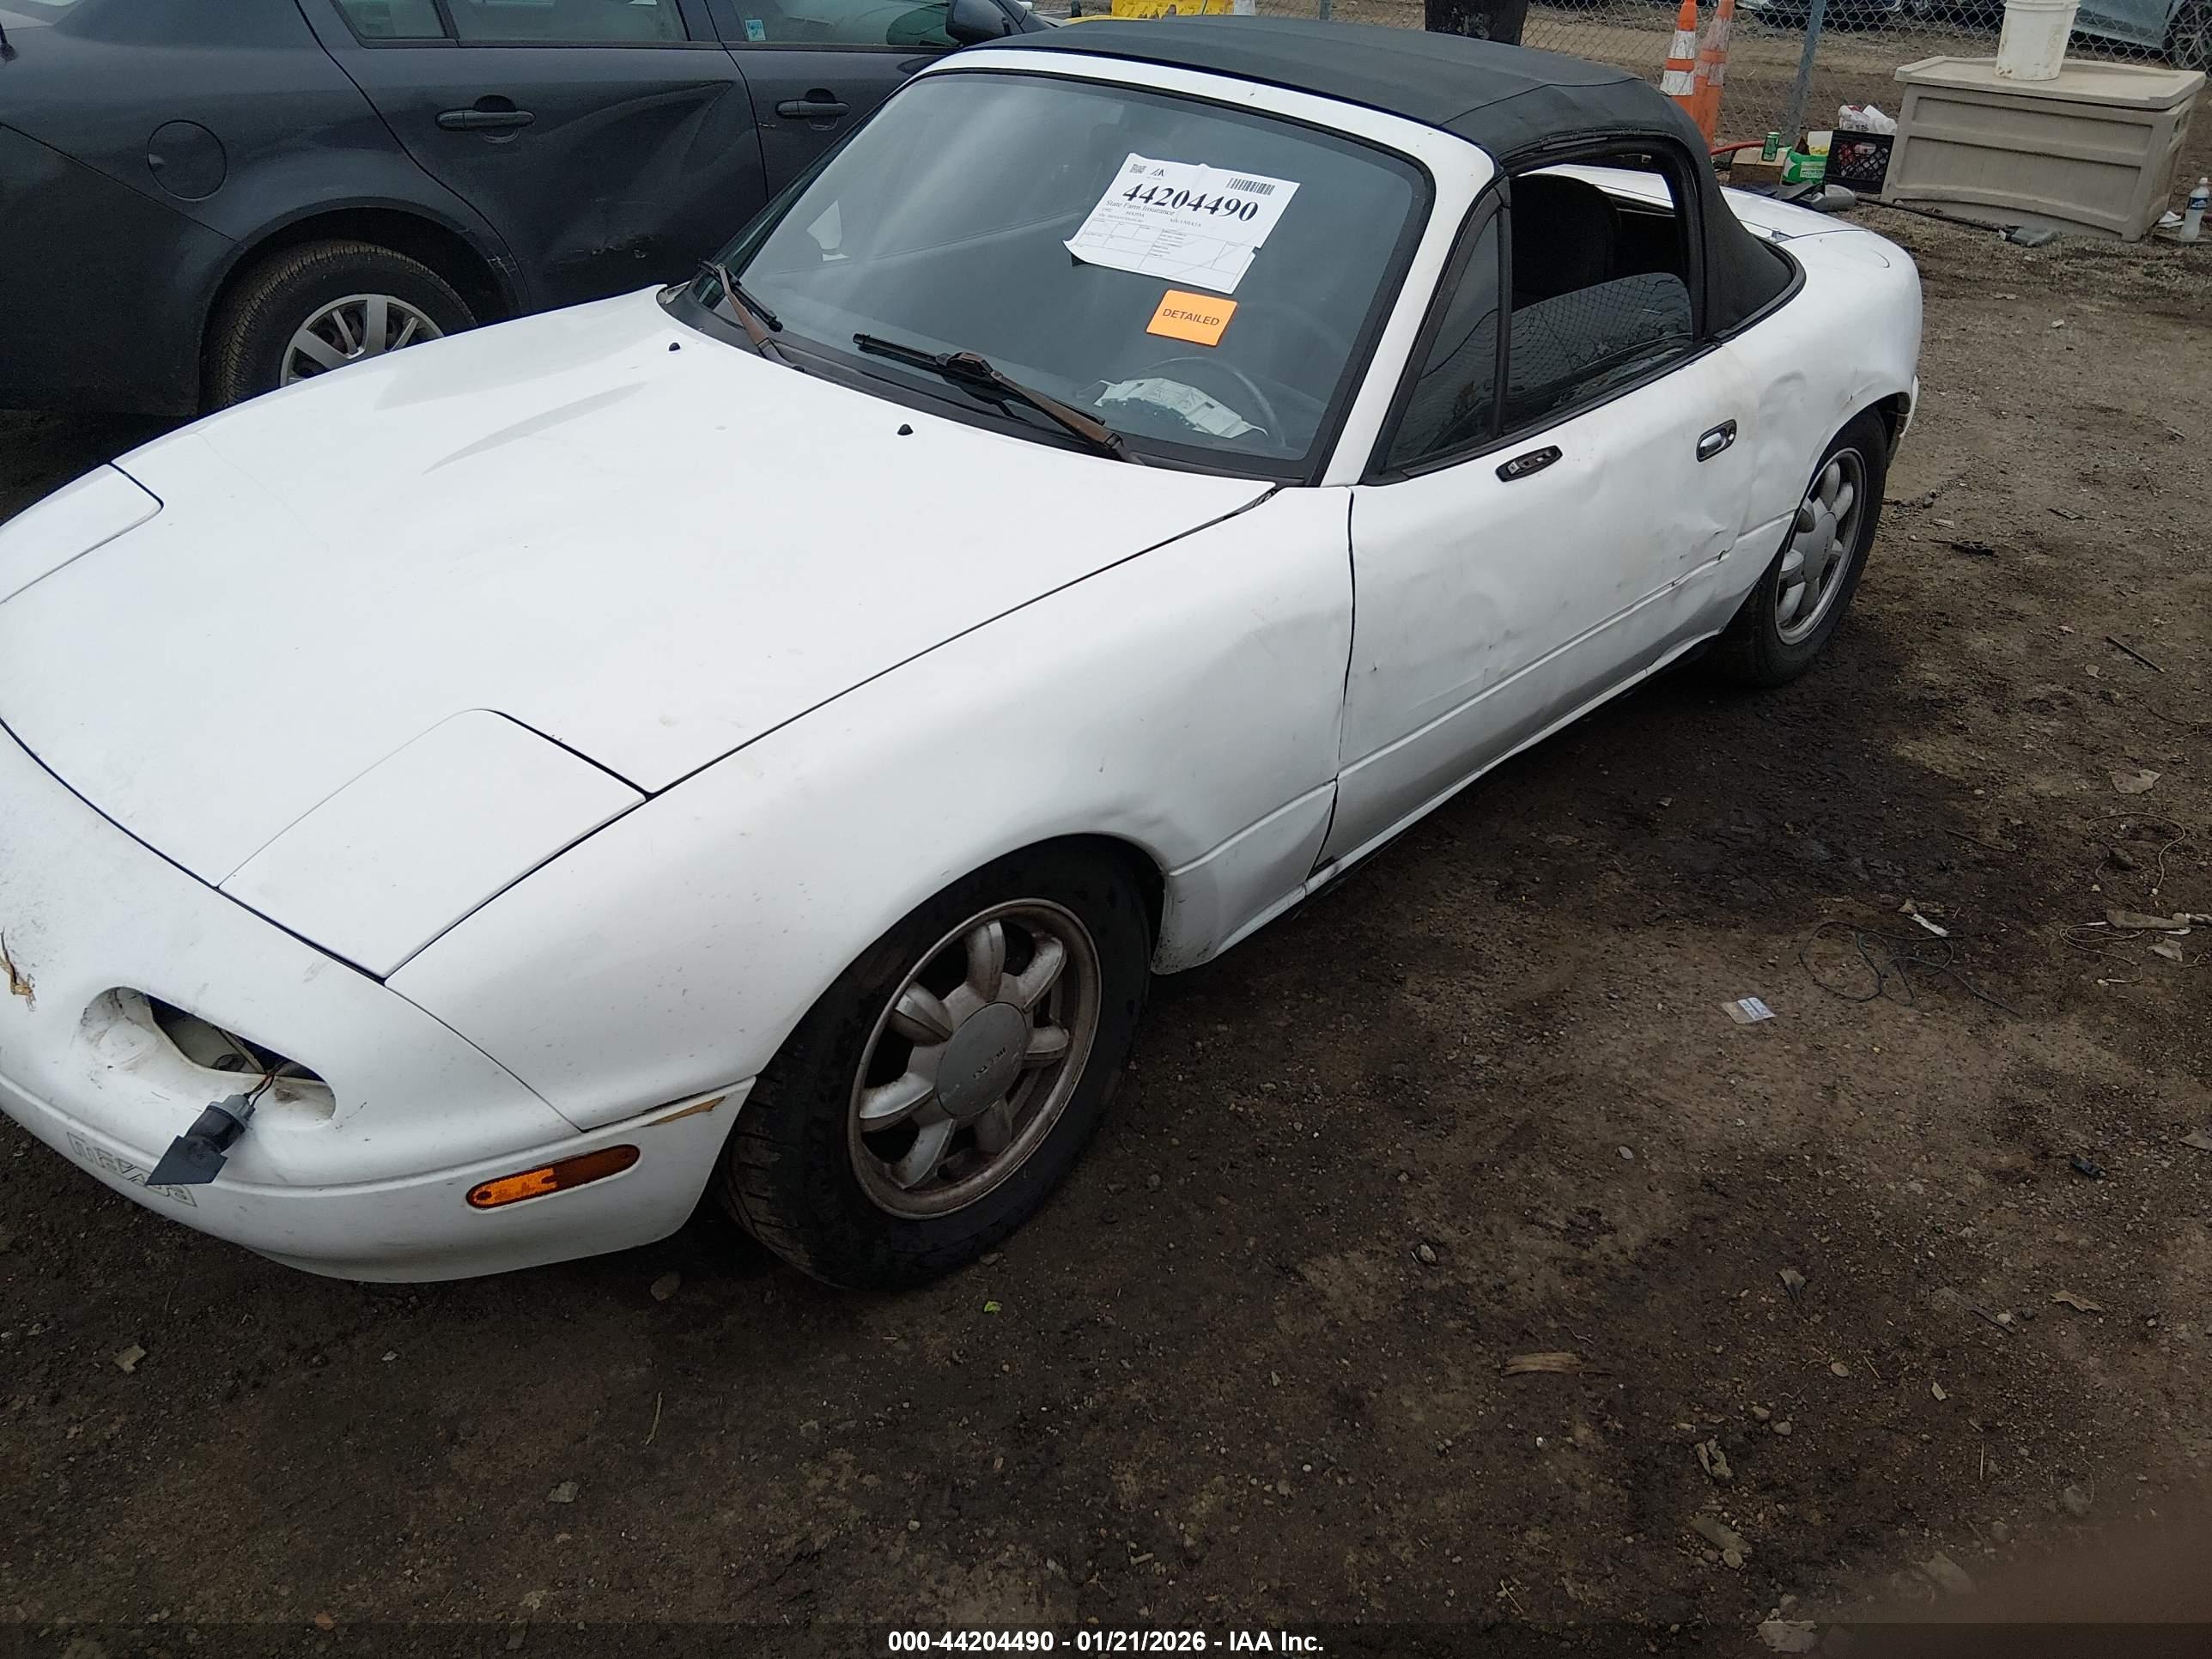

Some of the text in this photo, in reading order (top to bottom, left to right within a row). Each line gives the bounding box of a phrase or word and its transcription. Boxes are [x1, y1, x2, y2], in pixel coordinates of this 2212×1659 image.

[1122, 183, 1259, 222] 44204490
[1123, 203, 1140, 211] Farm
[1142, 206, 1176, 216] Insurance
[1163, 307, 1220, 327] DETAILED
